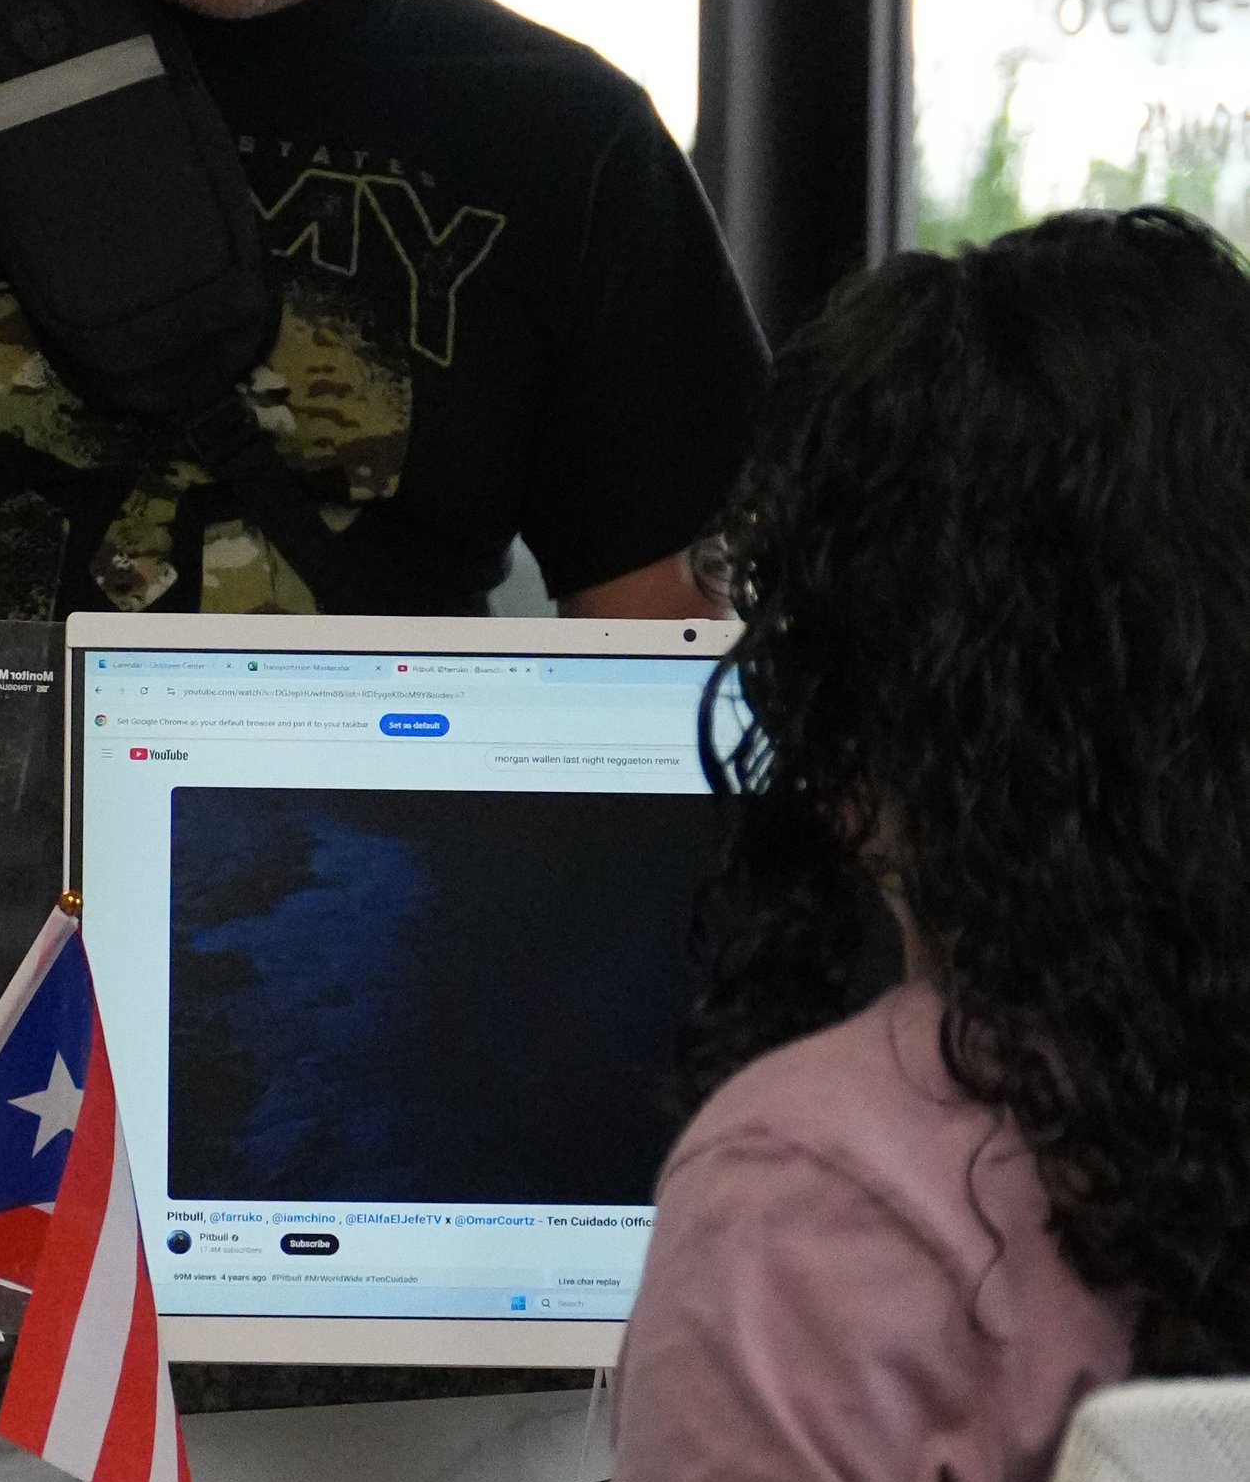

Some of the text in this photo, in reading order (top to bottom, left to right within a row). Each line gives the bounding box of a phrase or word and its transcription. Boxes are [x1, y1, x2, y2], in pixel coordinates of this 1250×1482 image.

[239, 134, 437, 189] STATES
[116, 717, 129, 725] Set
[130, 717, 158, 727] Google
[159, 717, 189, 726] Chrome
[199, 720, 217, 728] your
[218, 718, 245, 727] default
[246, 719, 275, 727] browser
[277, 719, 292, 727] and
[293, 720, 306, 729] pin
[314, 720, 322, 728] to
[323, 721, 341, 729] your
[342, 720, 369, 728] taskbar
[388, 721, 402, 729] Set
[413, 720, 441, 729] default
[149, 749, 189, 761] YouTube
[494, 755, 680, 767] morgan wallen last night reggaeton remix
[166, 1211, 207, 1224] Pitbull,
[209, 1211, 263, 1224] @farruko
[271, 1212, 336, 1225] @iamchino
[345, 1213, 442, 1227] @ElAlfaElJefeTV
[445, 1217, 452, 1225] x
[454, 1215, 536, 1228] @OmarCourtz
[547, 1216, 568, 1227] Ten
[570, 1216, 618, 1227] Cuidado
[199, 1232, 229, 1242] Pitbull
[289, 1239, 331, 1249] Subscribe
[173, 1273, 192, 1282] 69M
[193, 1273, 217, 1282] views
[227, 1275, 250, 1284] years
[251, 1276, 267, 1284] ago
[271, 1274, 302, 1282] #Pitbull
[304, 1274, 363, 1283] #MrWorldWide
[365, 1275, 419, 1284] #TenCuidado
[558, 1277, 621, 1288] Live chat replay
